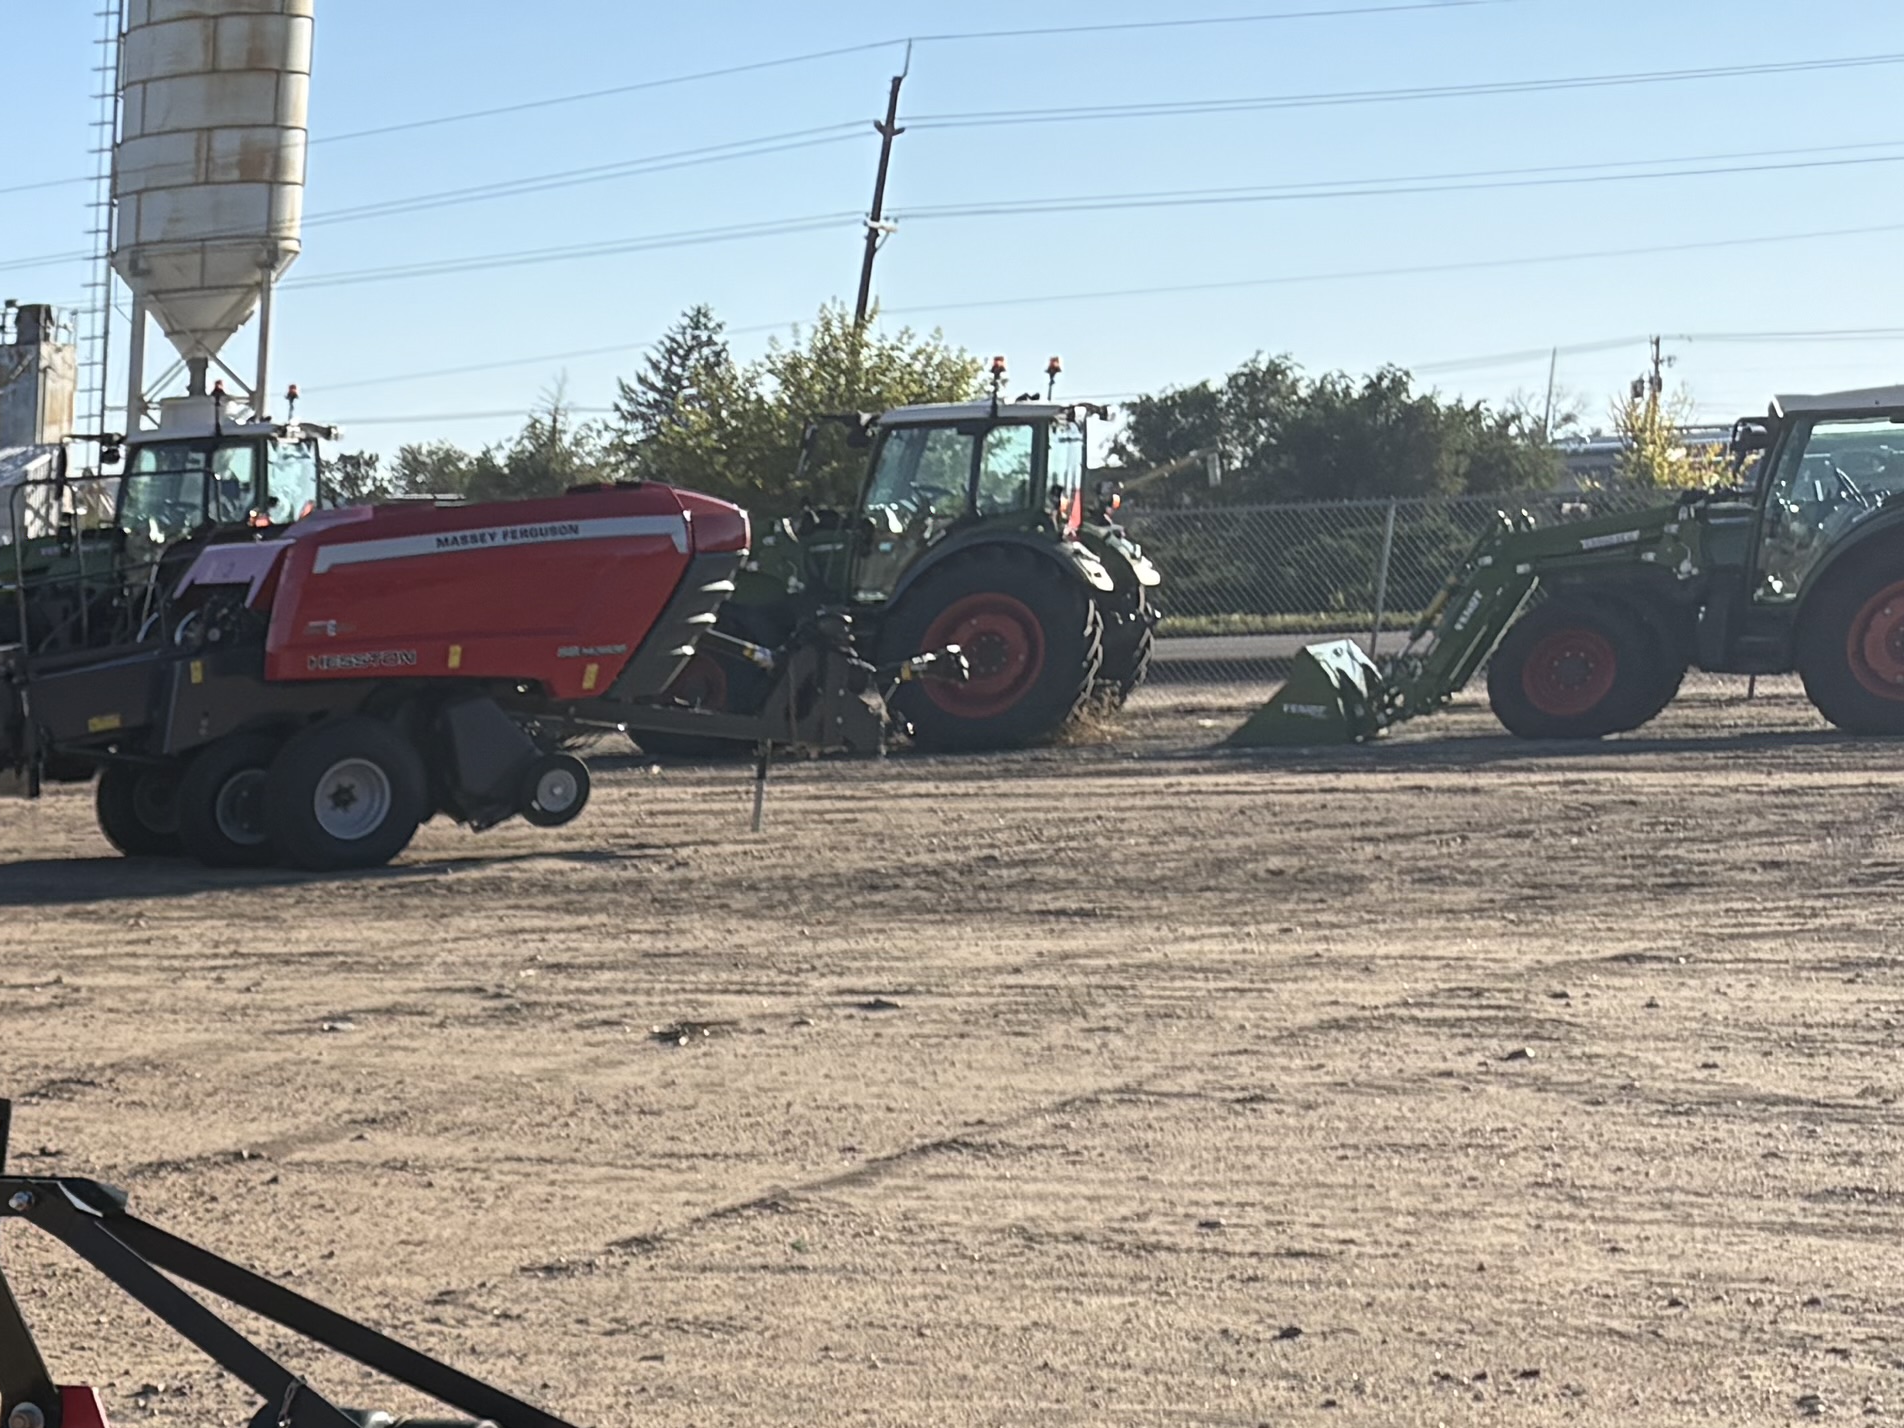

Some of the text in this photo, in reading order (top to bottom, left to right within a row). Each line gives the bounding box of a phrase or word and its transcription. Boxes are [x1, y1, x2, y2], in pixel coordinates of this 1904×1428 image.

[435, 523, 580, 549] MASSEY FERGUSON
[307, 649, 418, 672] HESSTON
